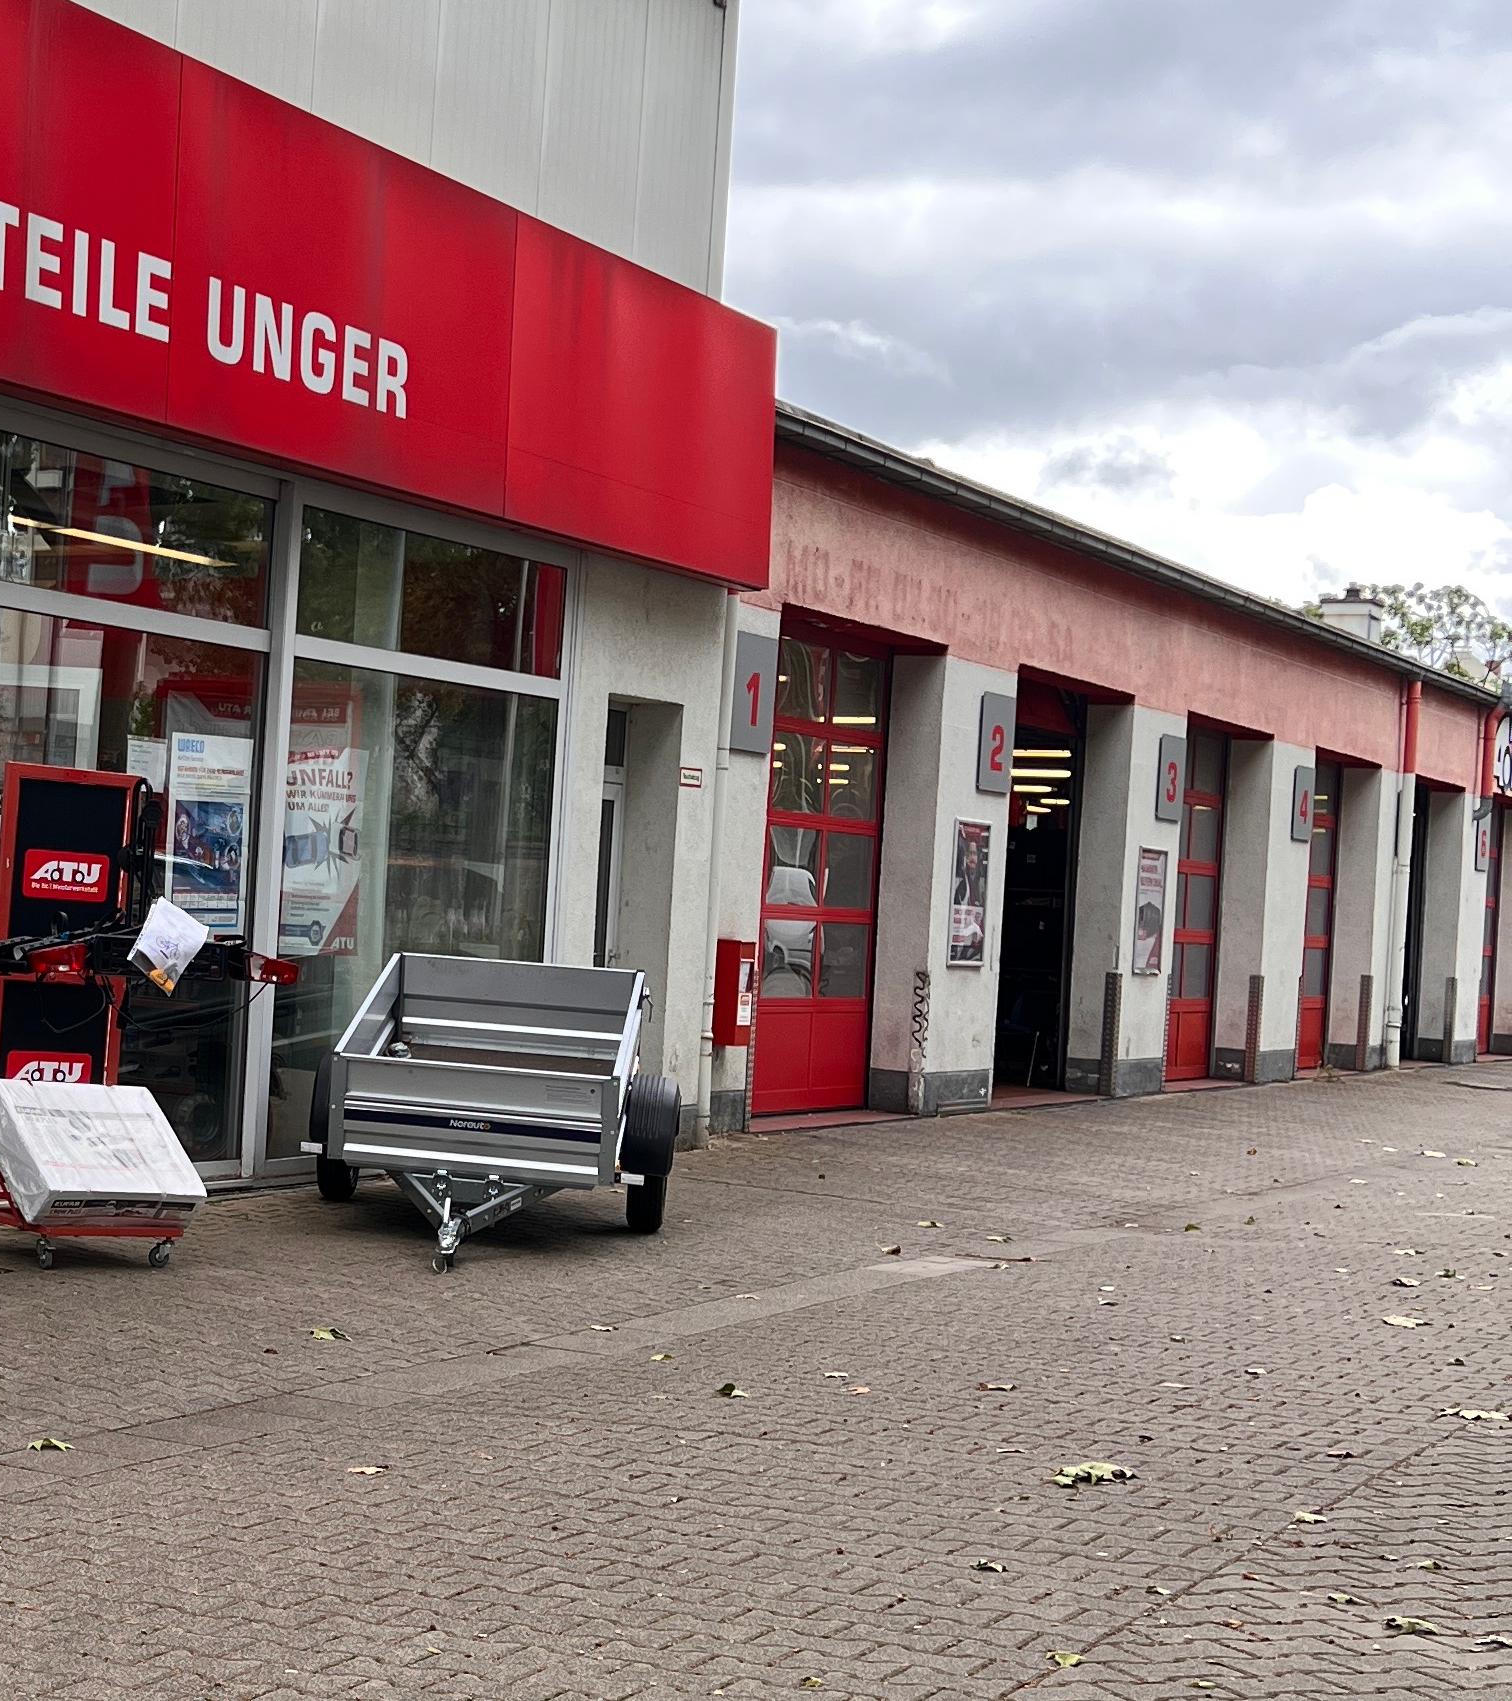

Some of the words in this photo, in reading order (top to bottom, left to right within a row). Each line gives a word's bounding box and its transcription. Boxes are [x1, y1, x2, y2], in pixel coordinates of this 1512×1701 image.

[205, 275, 409, 419] UNGER
[745, 672, 760, 726] 1
[990, 725, 1004, 772] 2
[286, 768, 353, 790] UNFALL?
[1166, 762, 1177, 802] 3
[286, 789, 307, 799] WIR
[287, 801, 306, 811] UM
[1299, 790, 1308, 824] 4
[29, 860, 103, 884] ATU
[330, 937, 354, 950] ATU
[12, 1060, 85, 1083] ATU
[449, 1118, 491, 1131] Norauto
